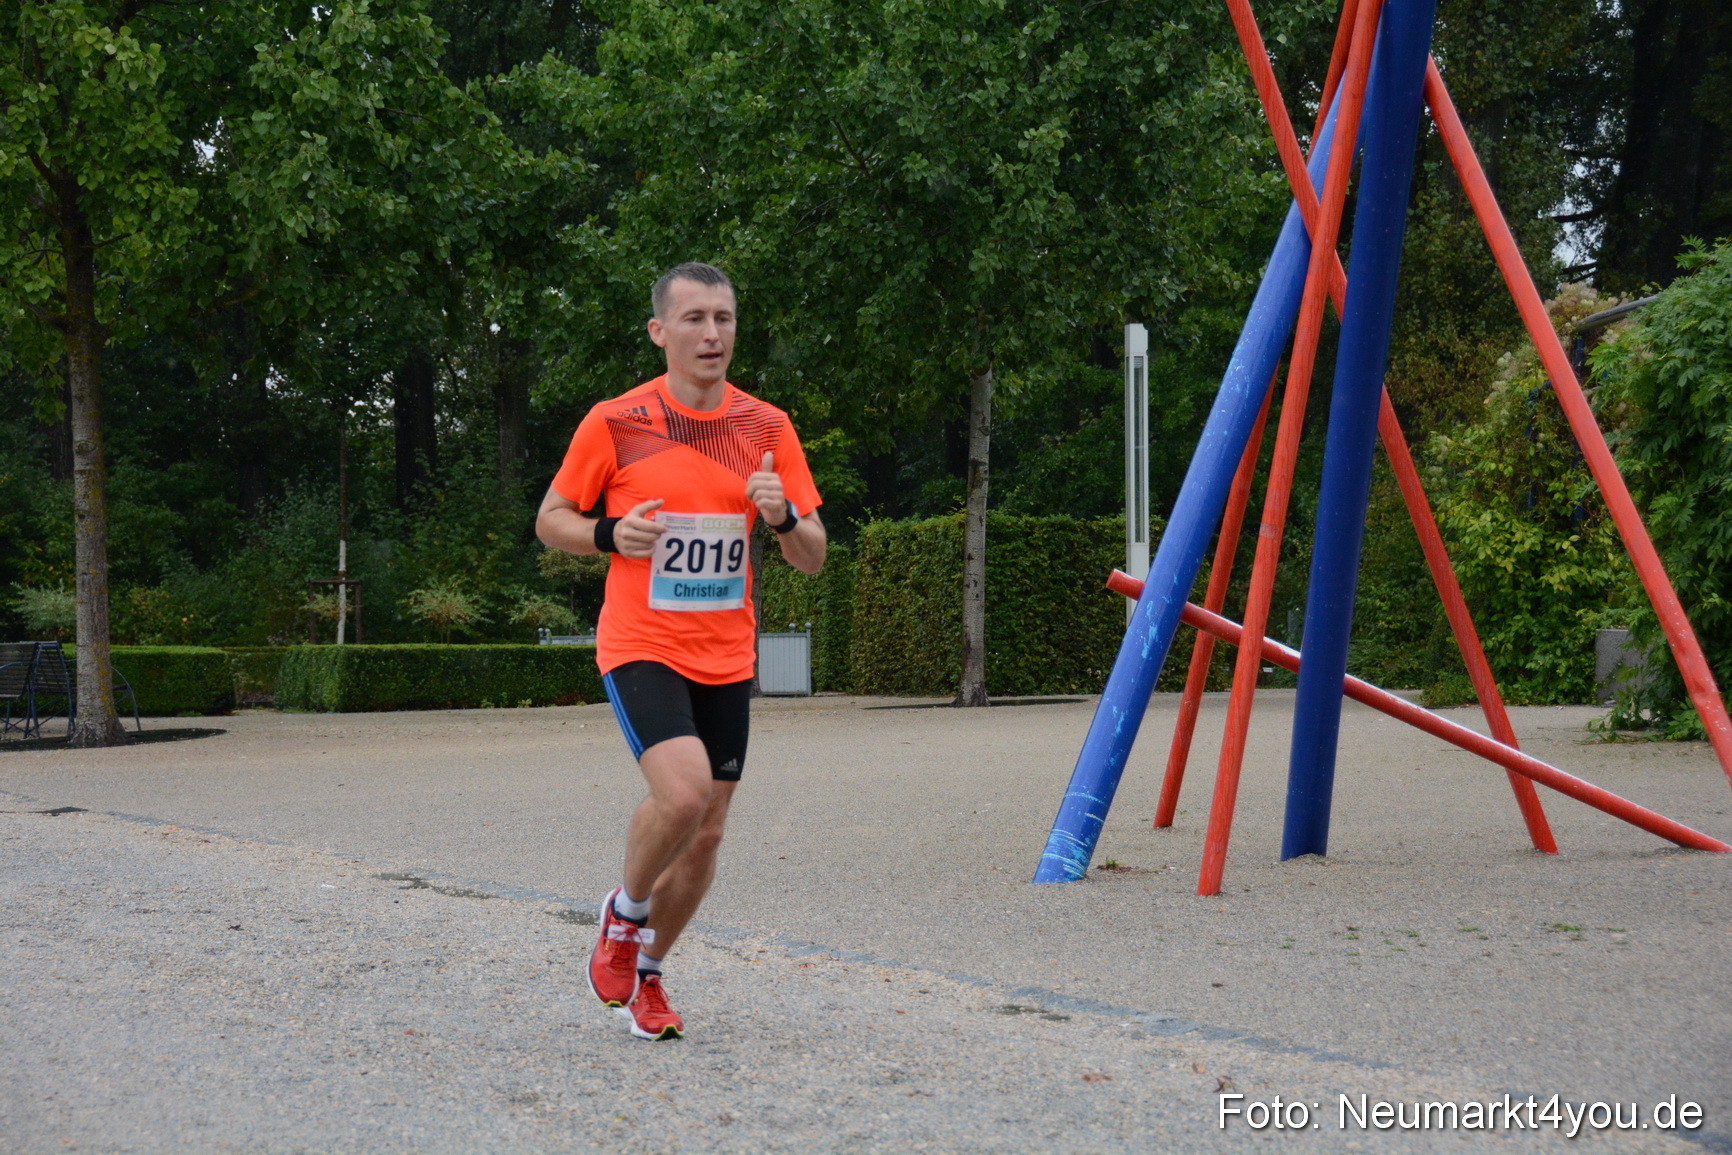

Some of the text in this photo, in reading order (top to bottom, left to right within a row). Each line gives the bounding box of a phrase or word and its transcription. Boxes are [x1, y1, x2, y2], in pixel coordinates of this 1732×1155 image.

[616, 410, 653, 426] adidas
[664, 537, 745, 573] 2019
[674, 583, 729, 598] Christian
